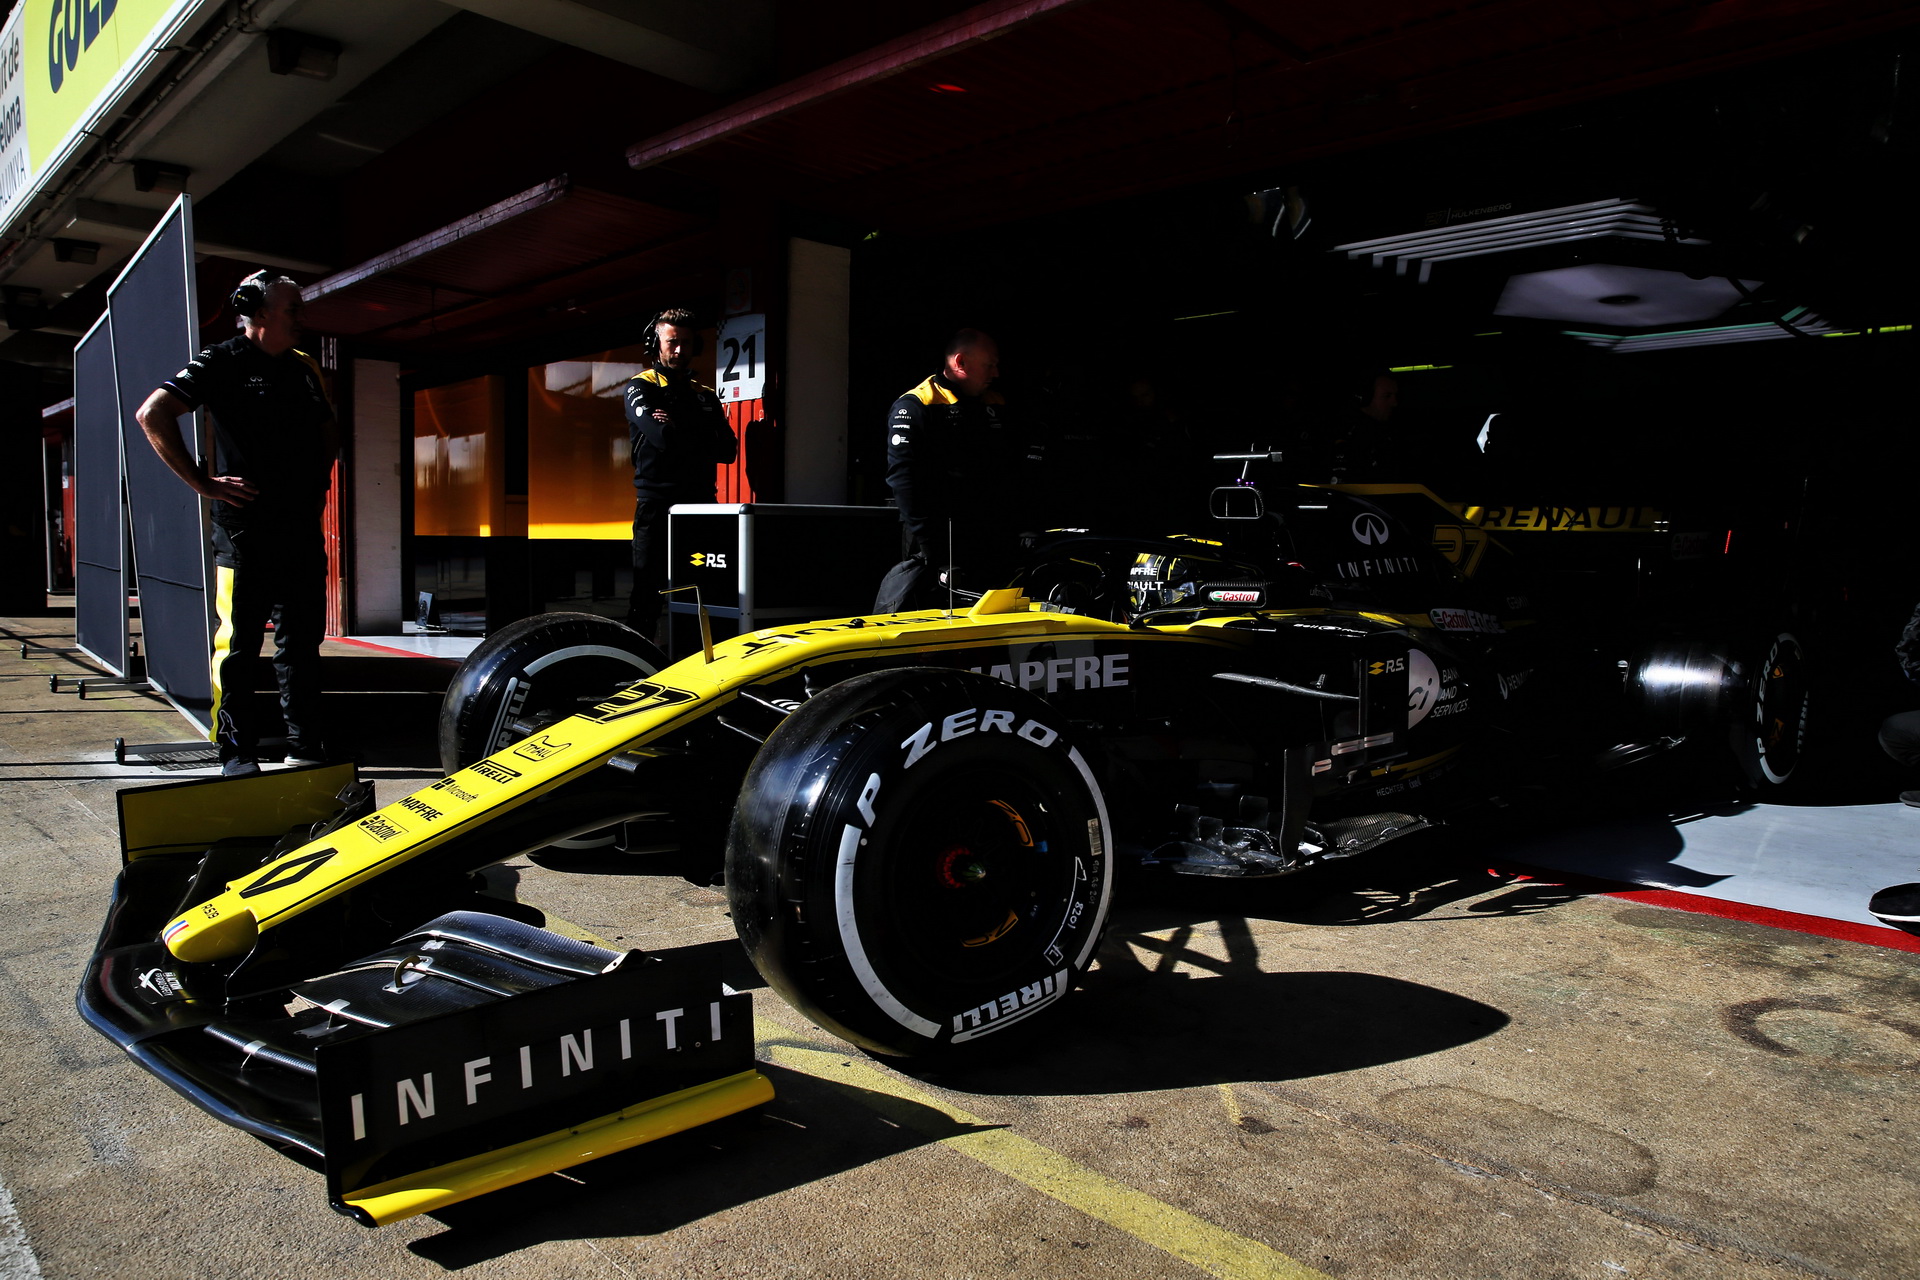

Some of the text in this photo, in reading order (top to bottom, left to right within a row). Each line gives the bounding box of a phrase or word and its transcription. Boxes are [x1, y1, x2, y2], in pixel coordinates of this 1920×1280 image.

[723, 334, 755, 382] 21
[1129, 567, 1158, 576] APFRE
[1336, 557, 1419, 578] INFINITI
[1222, 592, 1256, 602] Castrol
[970, 653, 1129, 694] APFRE
[1441, 667, 1459, 684] BANK
[1439, 685, 1457, 702] AND
[900, 708, 1059, 770] ZERO
[469, 759, 522, 785] PIRELLI
[445, 782, 480, 803] Microsoft
[398, 797, 443, 822] MAPFRE
[366, 820, 402, 840] Castrol
[950, 967, 1069, 1044] PIRELLI
[350, 1001, 722, 1141] INFINITI
